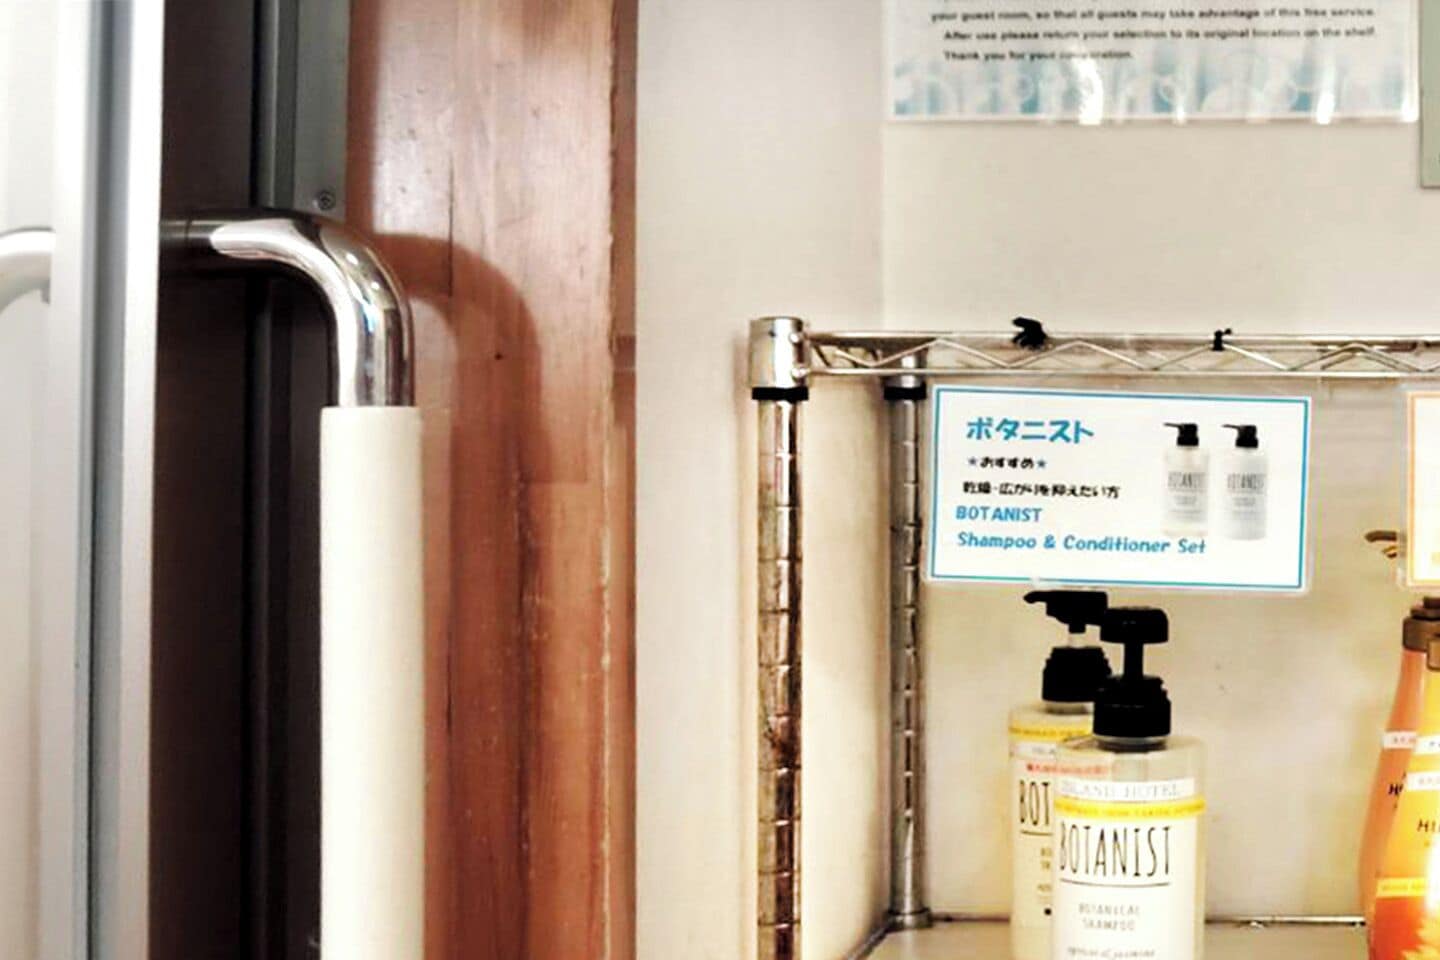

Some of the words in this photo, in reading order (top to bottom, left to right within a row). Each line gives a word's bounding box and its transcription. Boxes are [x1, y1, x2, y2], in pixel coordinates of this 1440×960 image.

[962, 11, 995, 22] guest
[1054, 10, 1077, 19] that
[1097, 10, 1138, 21] guests
[1141, 11, 1166, 20] may
[1169, 9, 1195, 18] take
[1200, 9, 1260, 19] advantage
[1264, 9, 1275, 17] of
[1279, 9, 1300, 17] this
[1304, 8, 1327, 16] free
[944, 31, 972, 40] After
[1001, 31, 1039, 41] please
[1043, 31, 1079, 39] return
[1083, 32, 1109, 40] your
[1113, 30, 1168, 39] selection
[1170, 30, 1183, 38] to
[1203, 29, 1250, 40] original
[1252, 29, 1300, 37] location
[1322, 28, 1341, 37] the
[944, 50, 980, 60] Thank
[984, 52, 1006, 61] you
[1009, 50, 1026, 58] for
[1029, 52, 1056, 61] your
[966, 415, 1096, 445] ボタニスト
[955, 505, 1043, 523] BOTANIST
[957, 531, 1038, 551] Shampoo
[1043, 534, 1057, 550] &
[1063, 534, 1171, 554] Conditioner
[1178, 538, 1206, 554] Set
[1060, 821, 1173, 878] BOTANIST
